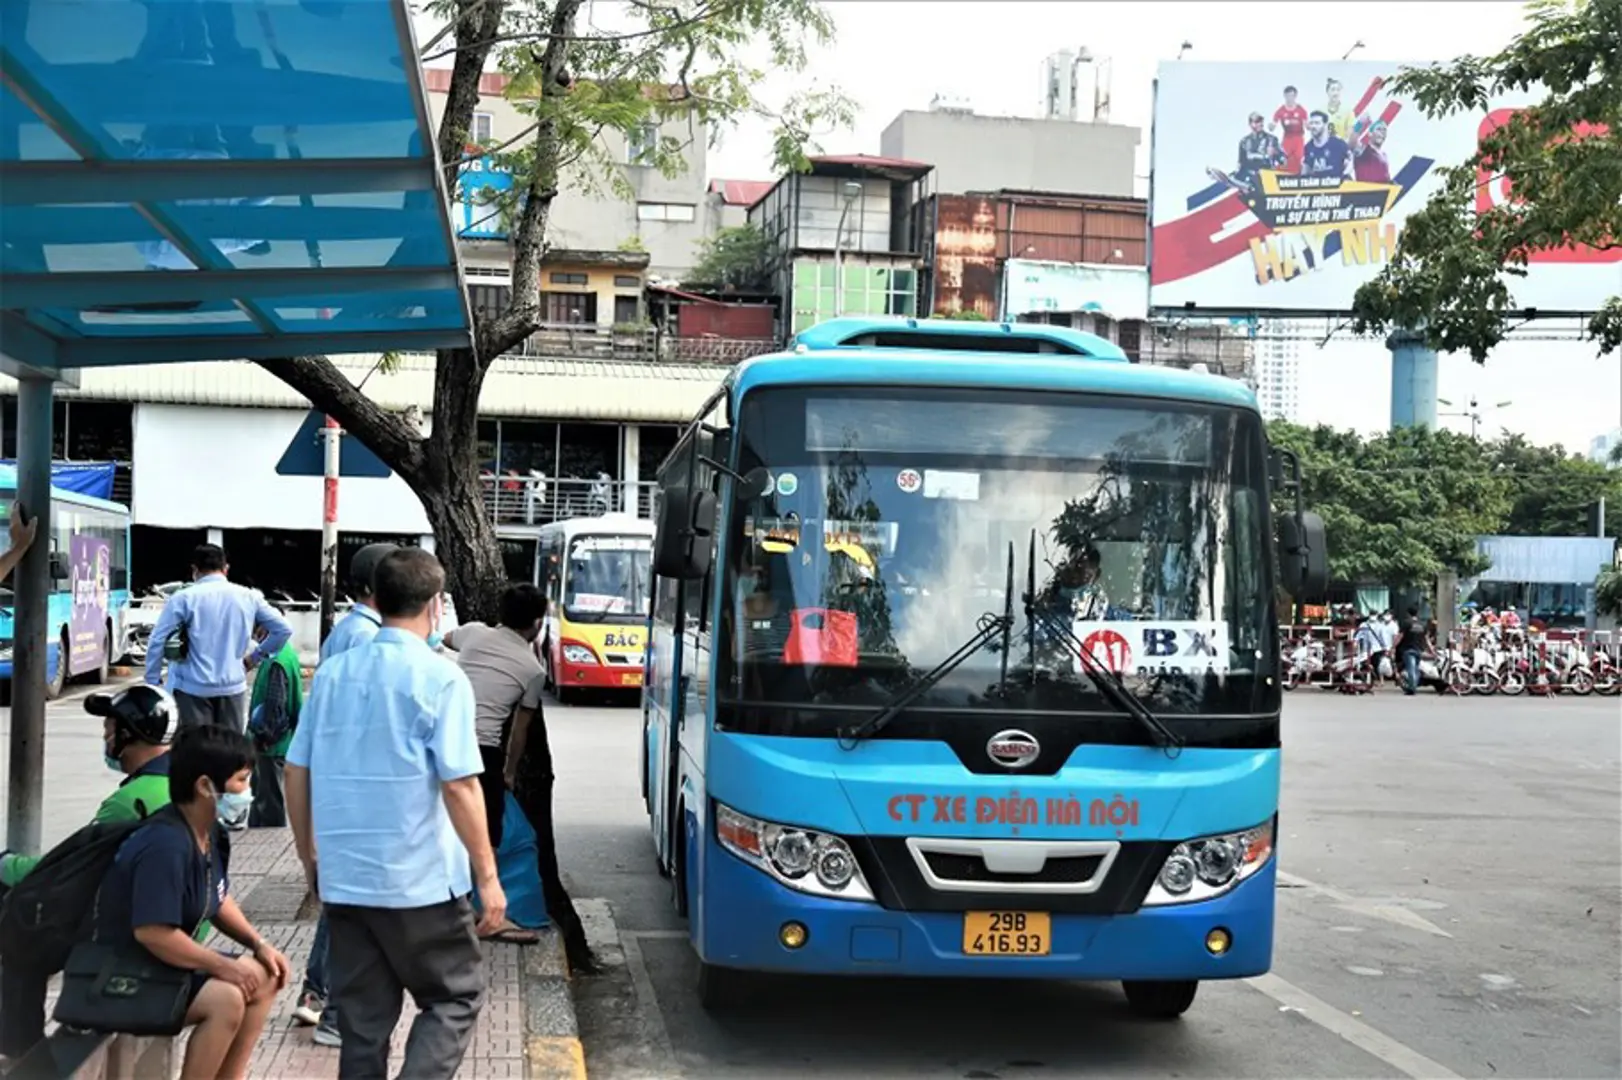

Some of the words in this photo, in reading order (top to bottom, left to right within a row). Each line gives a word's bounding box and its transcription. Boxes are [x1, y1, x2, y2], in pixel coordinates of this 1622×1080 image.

[1142, 628, 1218, 657] BX
[887, 794, 927, 823] CT
[932, 794, 967, 823] XE
[975, 789, 1039, 836] ĐIỆN
[1046, 791, 1082, 826] HÀ
[1089, 793, 1139, 837] NỘI
[988, 912, 1027, 932] 29B
[972, 933, 1041, 953] 416.93
